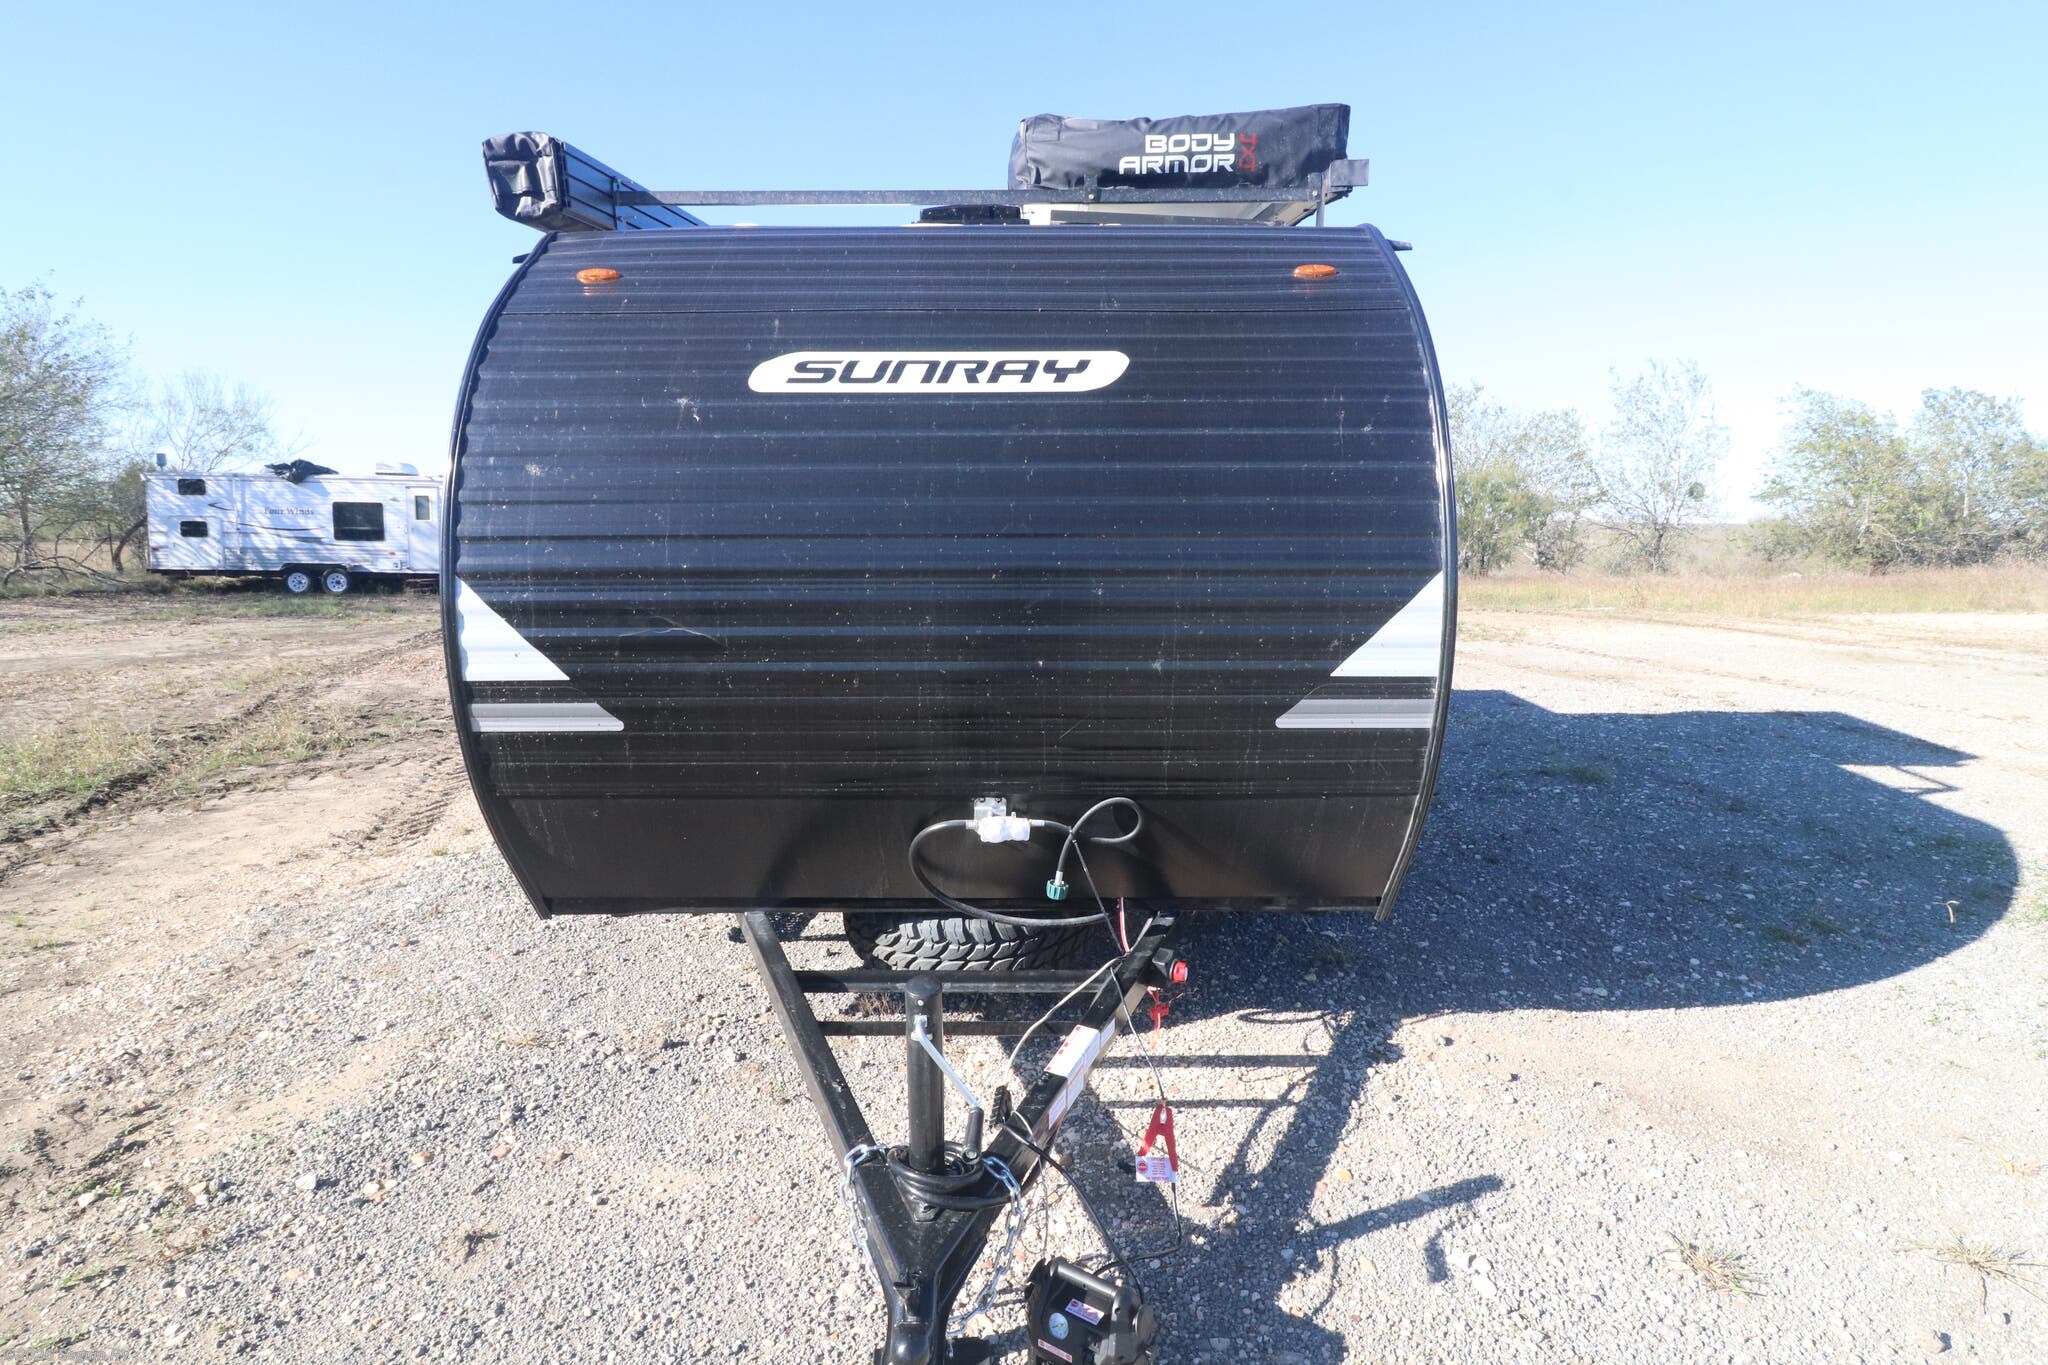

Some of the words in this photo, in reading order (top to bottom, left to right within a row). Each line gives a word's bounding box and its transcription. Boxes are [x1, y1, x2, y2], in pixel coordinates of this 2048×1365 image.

[1145, 133, 1235, 154] BODY
[1118, 154, 1236, 175] ARMOR
[786, 359, 1091, 384] SUNRAY
